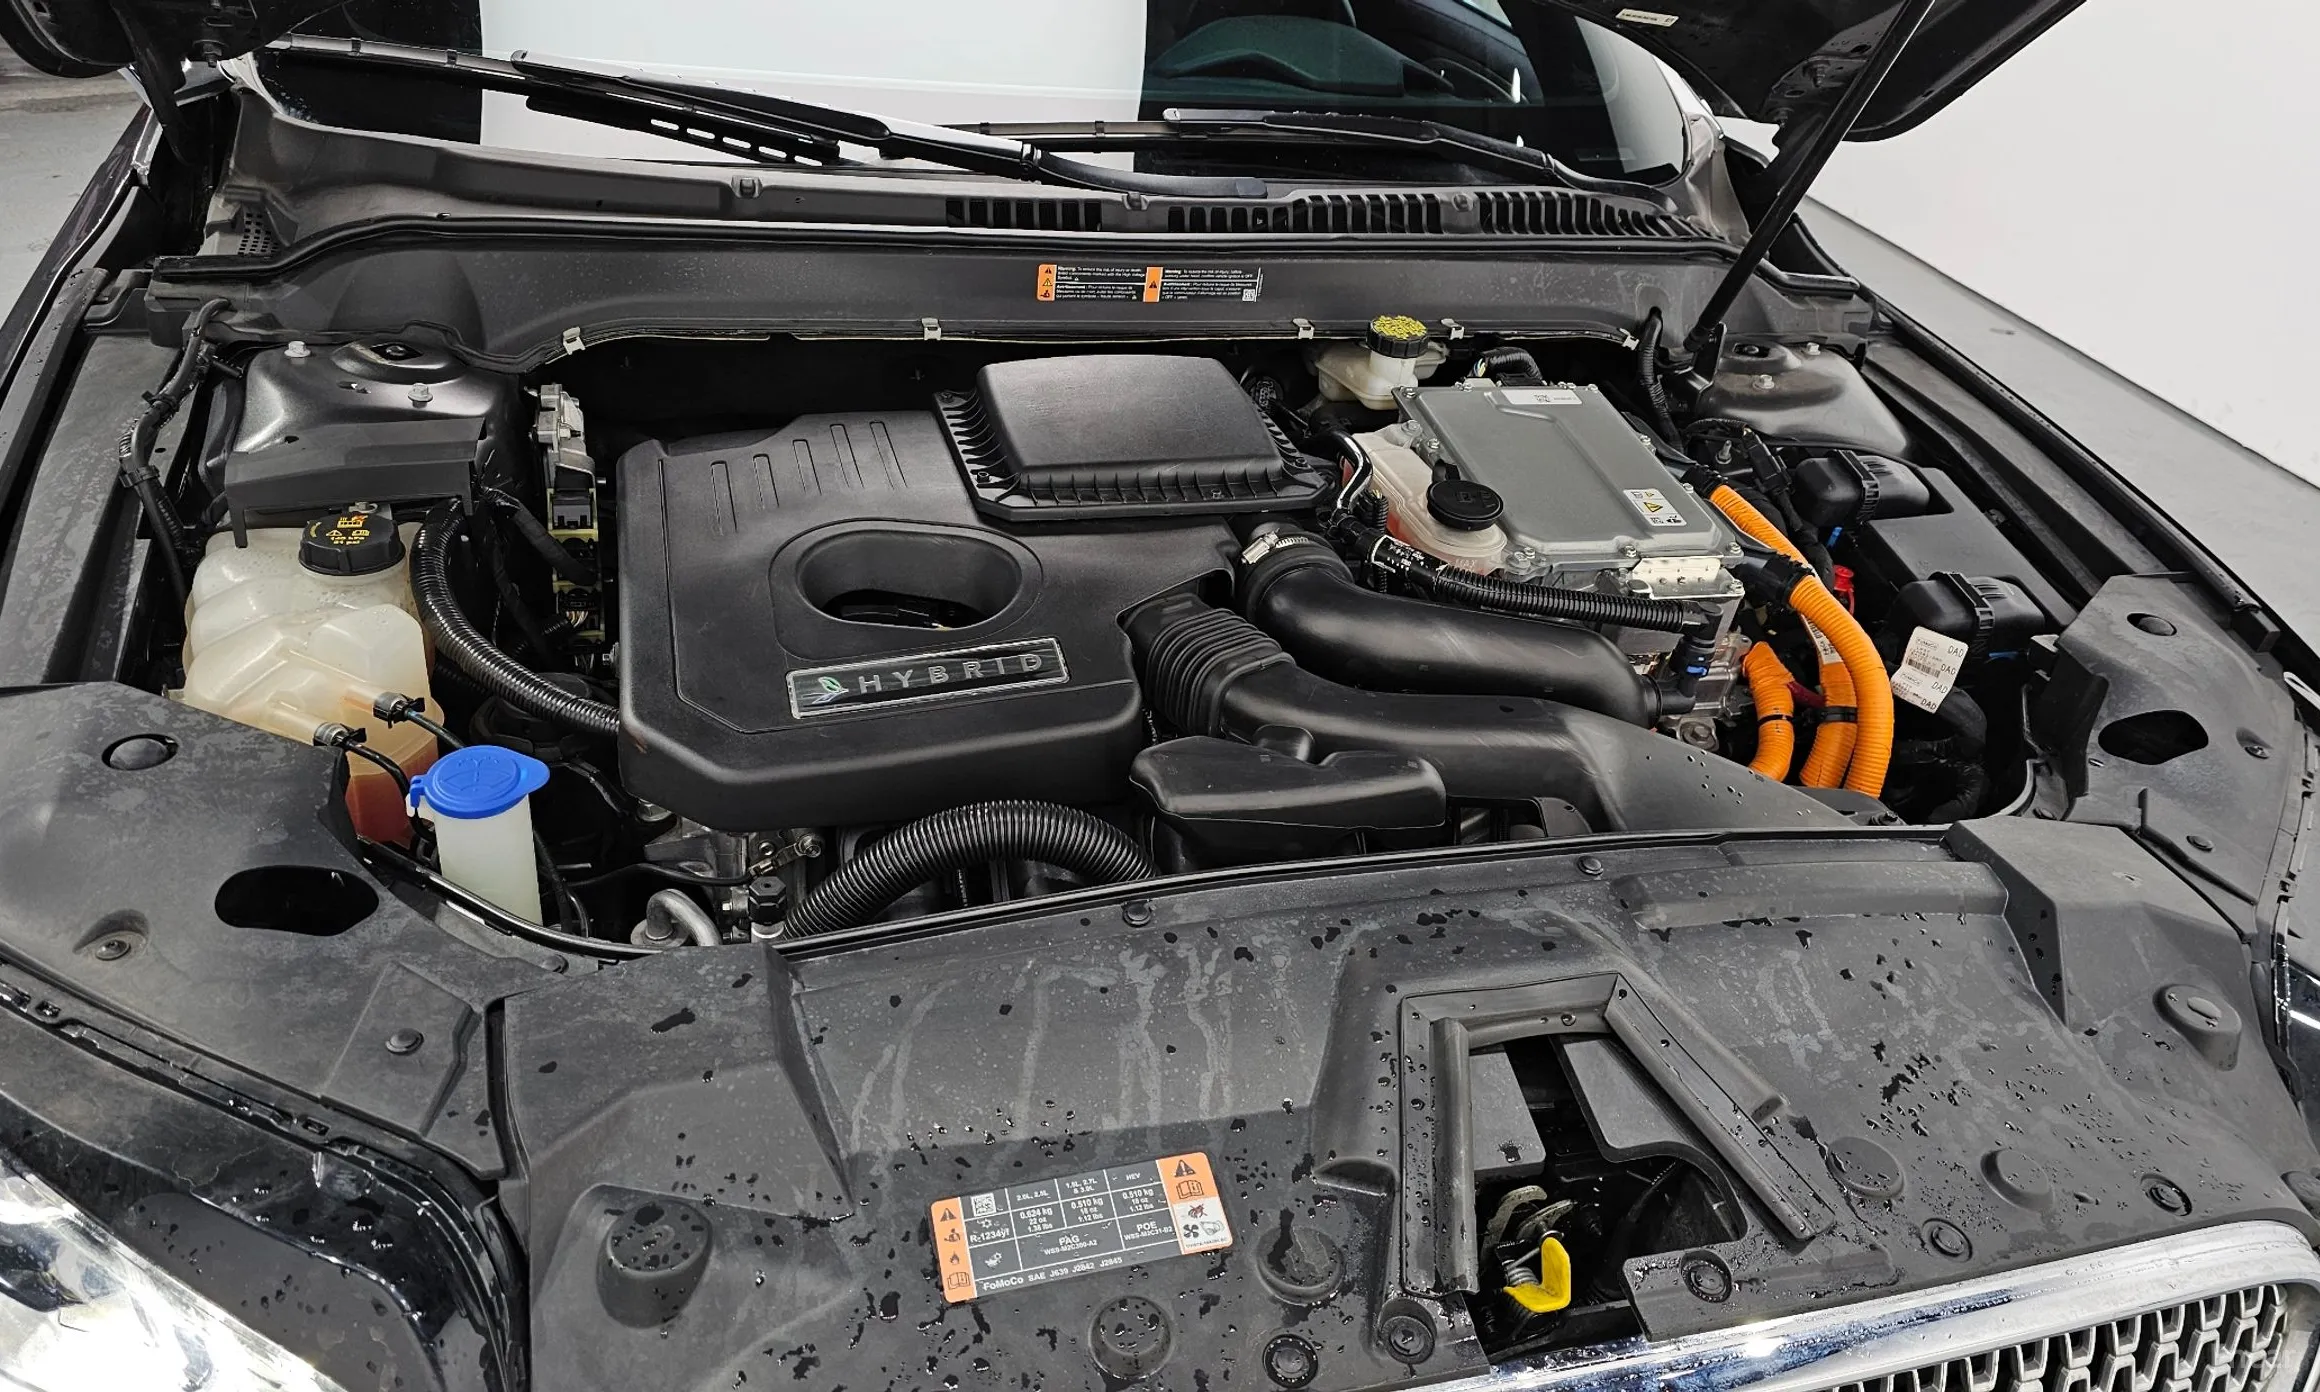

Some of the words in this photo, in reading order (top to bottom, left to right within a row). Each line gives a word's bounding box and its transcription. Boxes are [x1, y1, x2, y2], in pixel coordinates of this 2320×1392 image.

[858, 653, 1042, 694] HYBRID
[1122, 1189, 1143, 1200] 0.510
[1143, 1188, 1154, 1197] kg
[1070, 1199, 1092, 1209] 0.510
[1092, 1198, 1103, 1206] kg
[1041, 1207, 1053, 1216] kg
[1136, 1221, 1158, 1232] POE
[969, 1229, 1010, 1244] R-1234yf
[1058, 1234, 1080, 1246] PAG
[982, 1276, 1024, 1291] FoMoCo
[1028, 1271, 1046, 1282] SAE
[1050, 1267, 1069, 1278] J639
